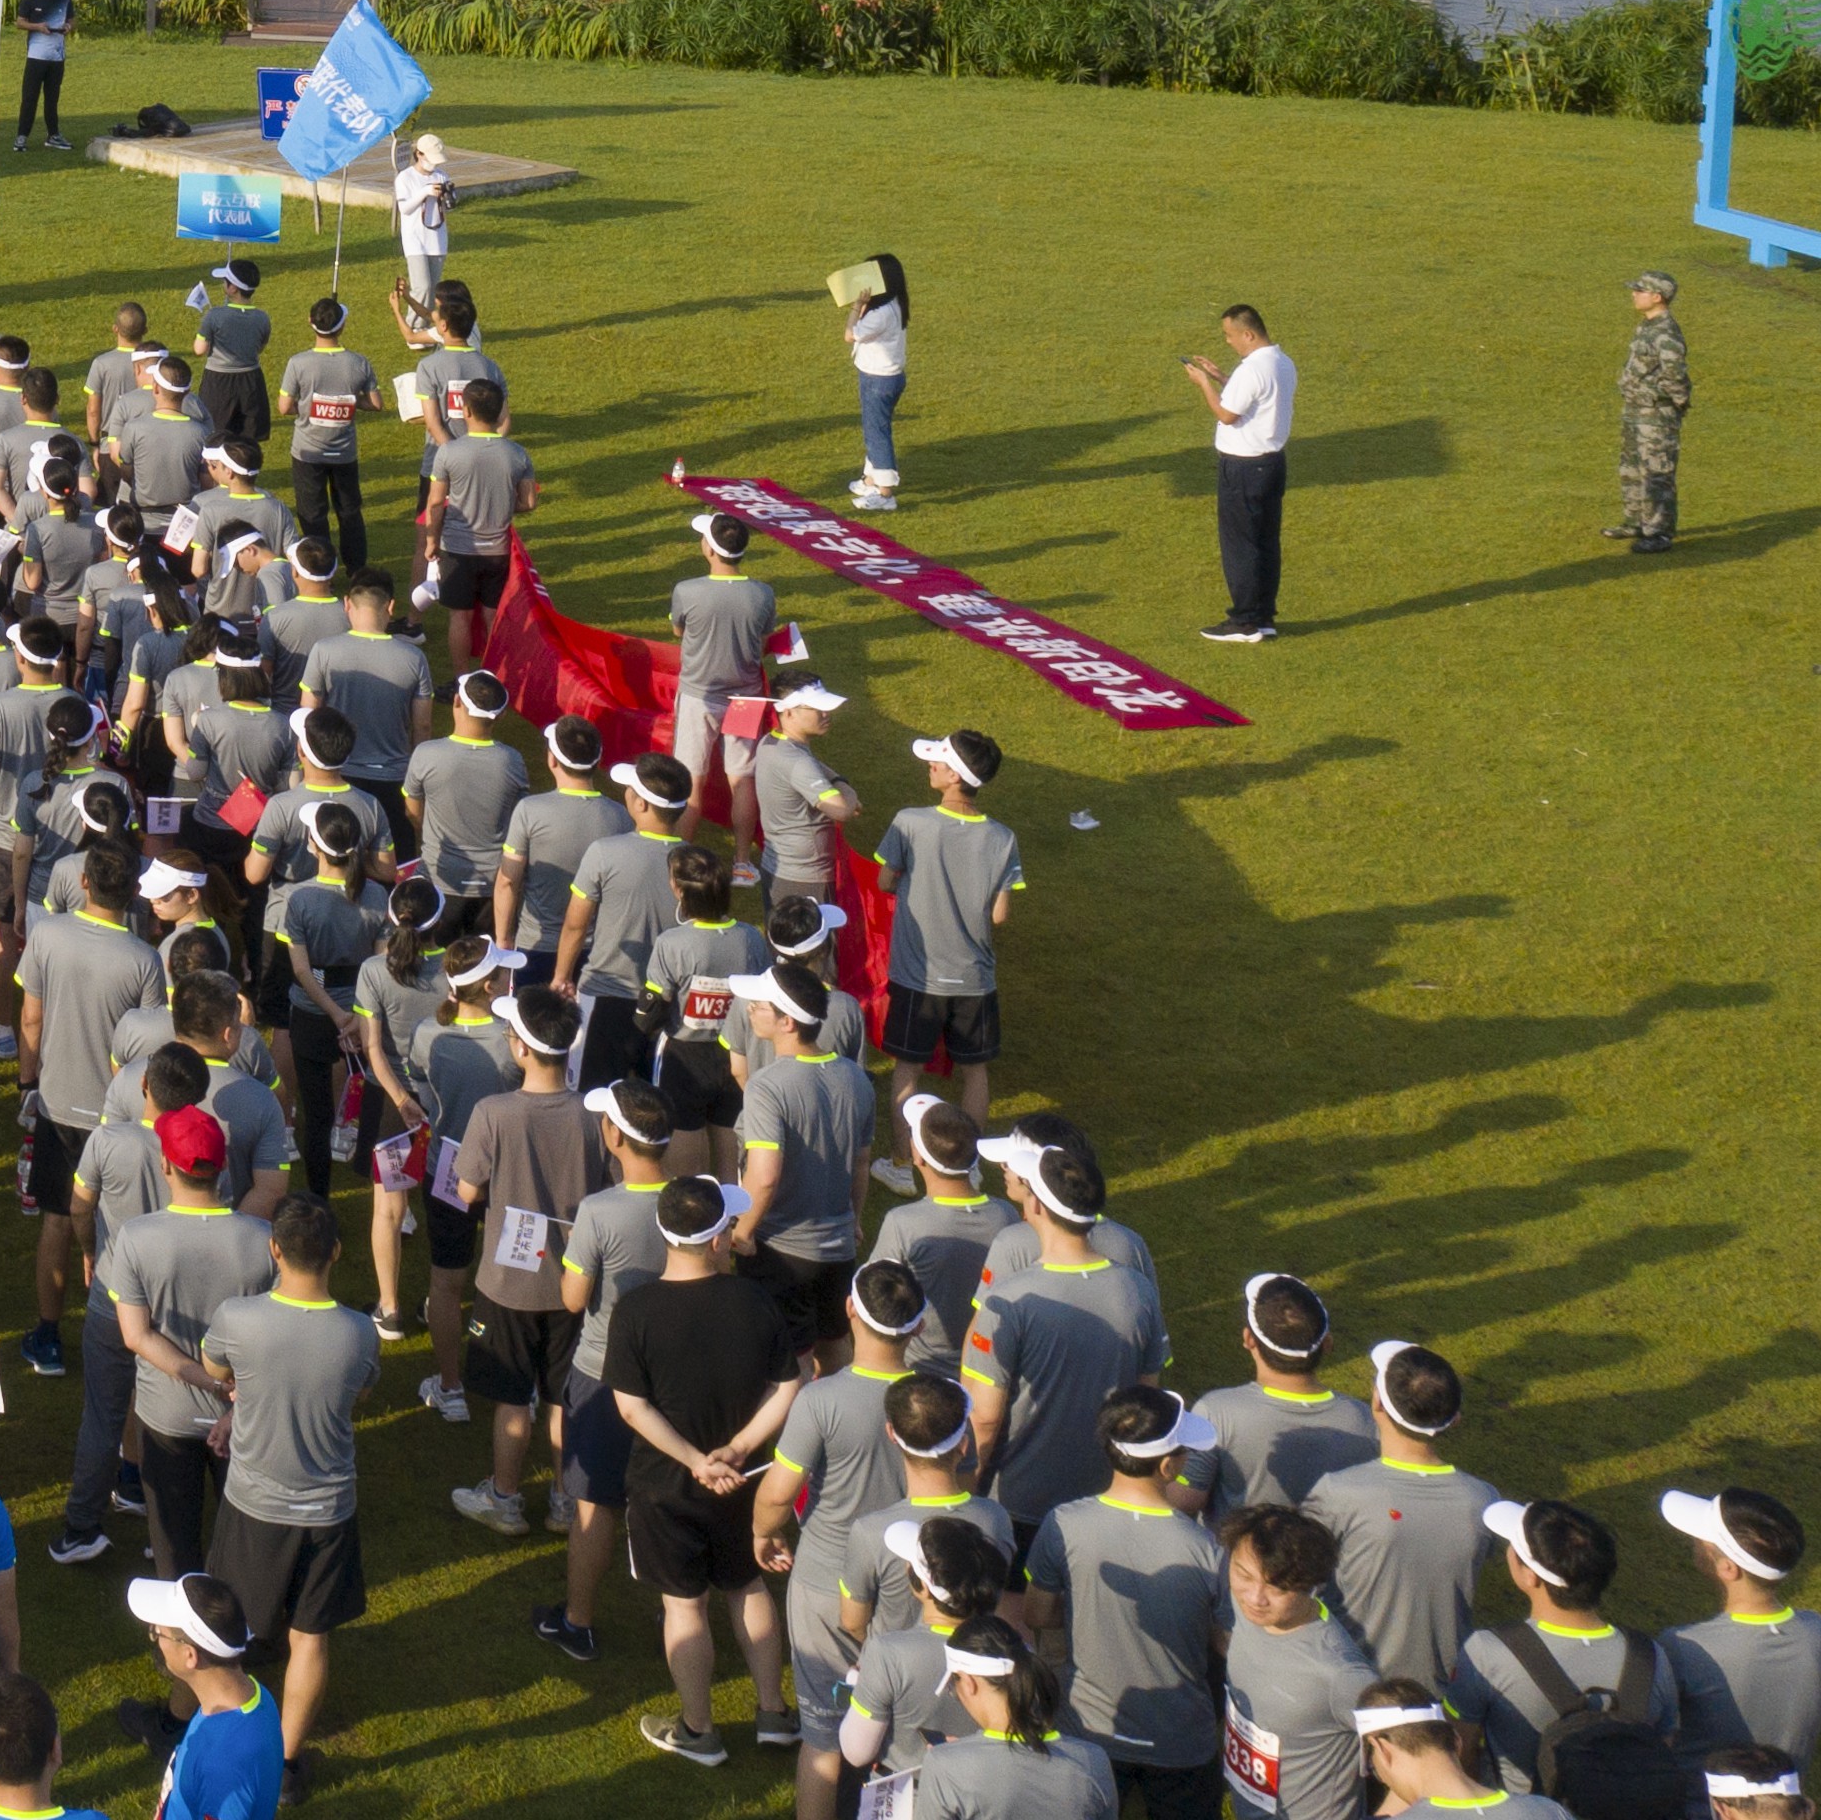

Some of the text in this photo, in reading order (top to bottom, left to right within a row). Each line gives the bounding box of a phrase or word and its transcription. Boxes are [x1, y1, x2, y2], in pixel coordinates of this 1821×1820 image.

[208, 208, 253, 226] 代表队
[315, 404, 350, 420] W503
[918, 592, 1190, 715] 建设新卧龙
